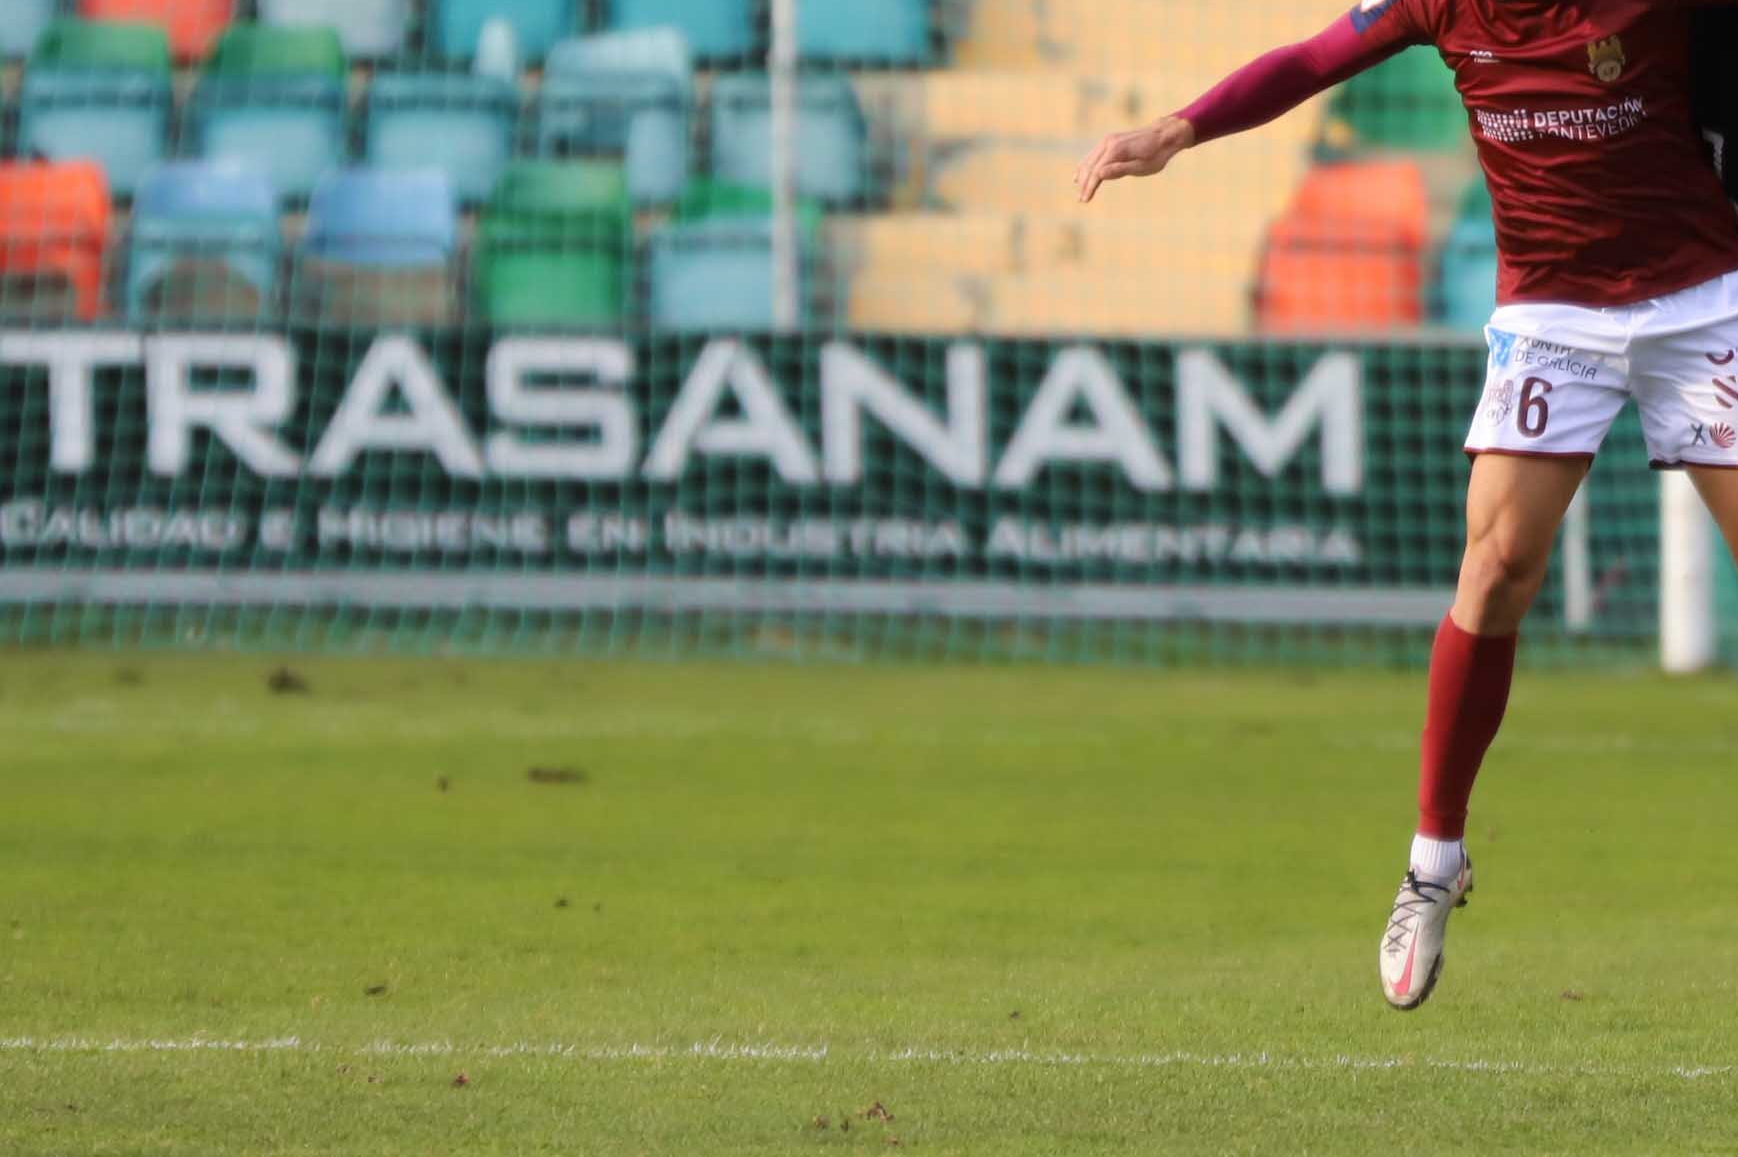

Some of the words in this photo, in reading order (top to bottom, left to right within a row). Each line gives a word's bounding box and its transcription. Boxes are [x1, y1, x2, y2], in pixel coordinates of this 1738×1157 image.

[1515, 349, 1535, 364] DE
[1537, 356, 1598, 380] GALICIA
[0, 331, 1363, 494] TRASANAM
[1517, 377, 1553, 439] 6
